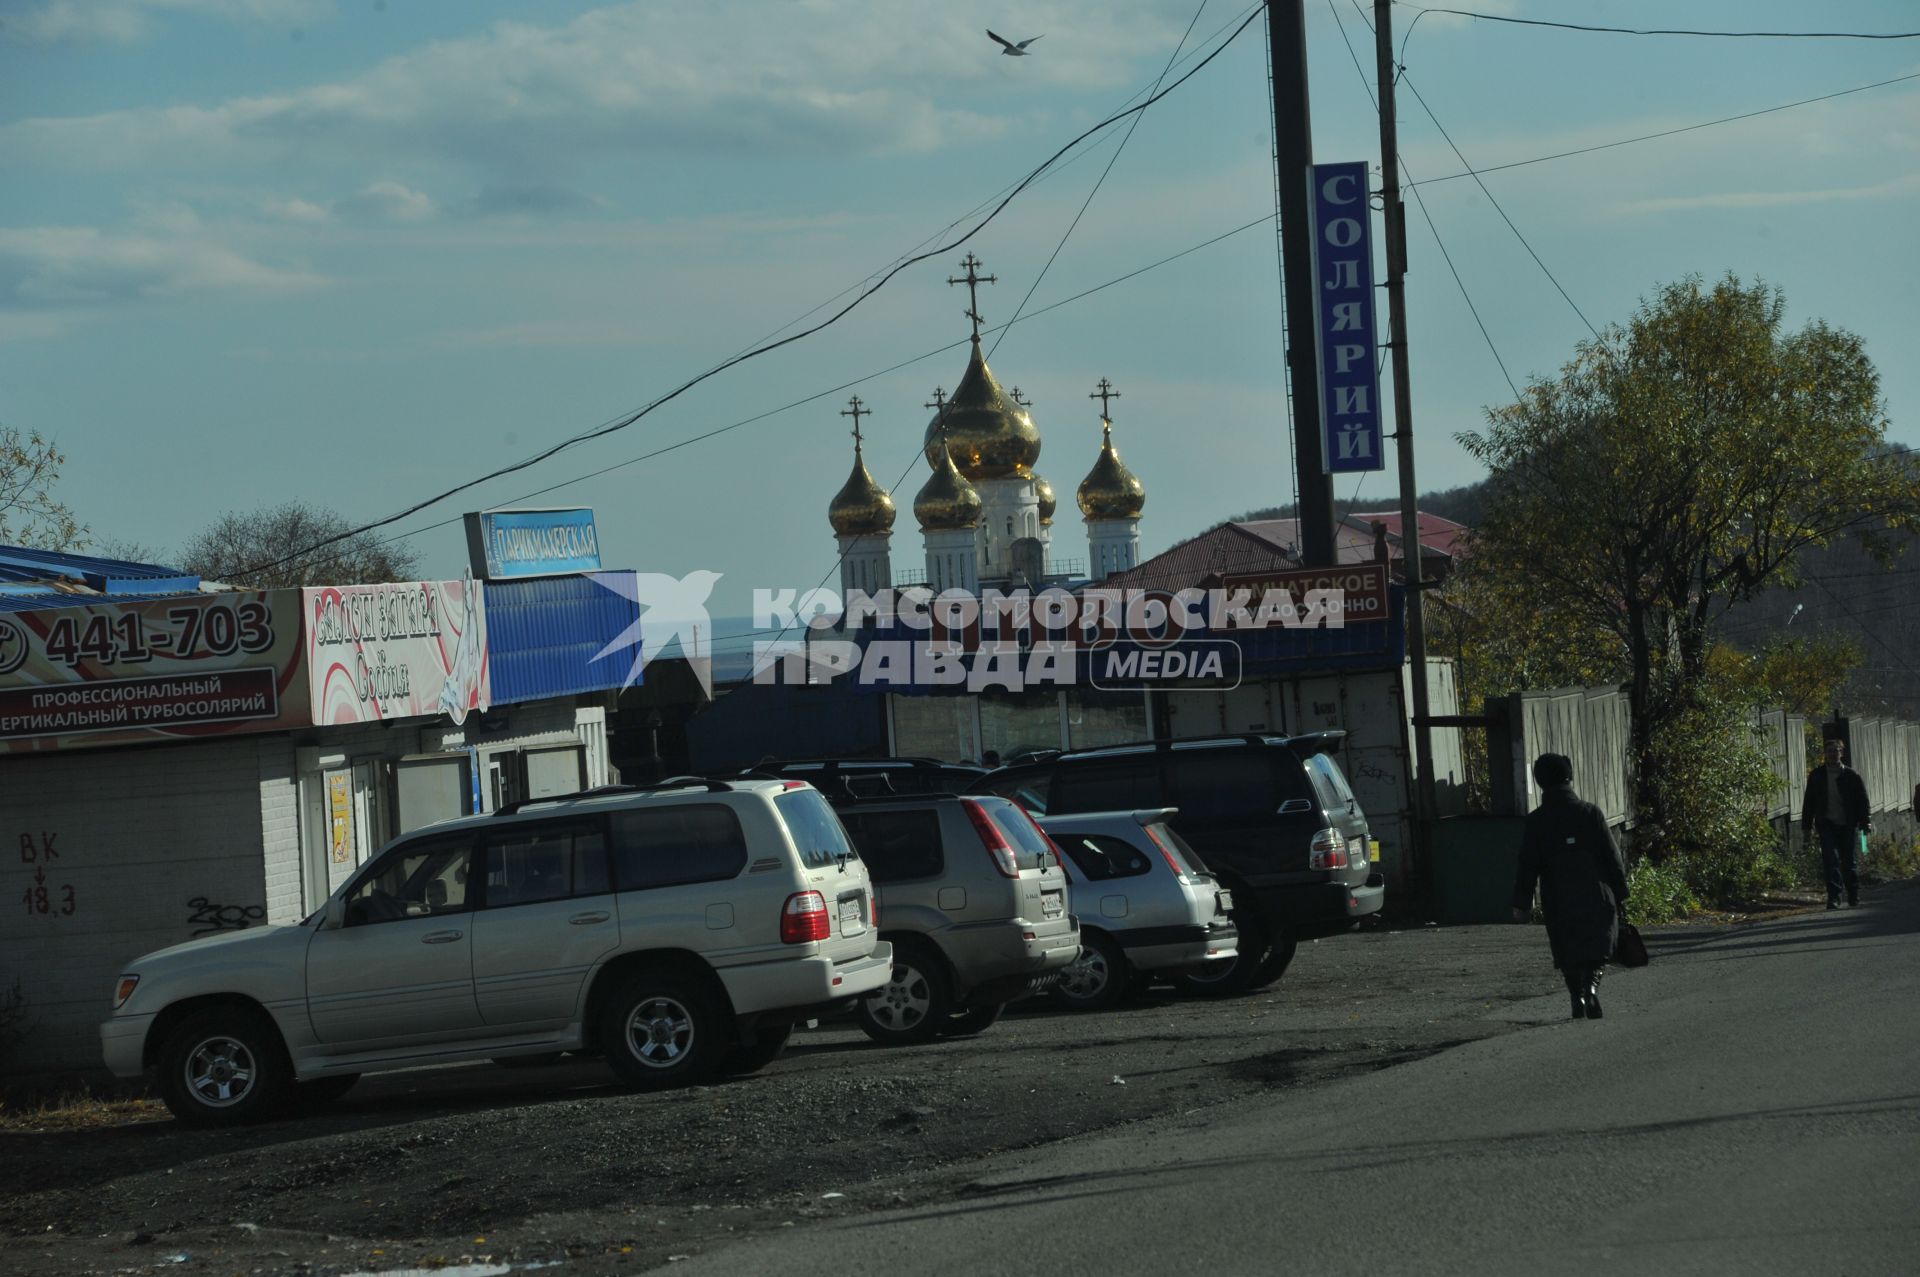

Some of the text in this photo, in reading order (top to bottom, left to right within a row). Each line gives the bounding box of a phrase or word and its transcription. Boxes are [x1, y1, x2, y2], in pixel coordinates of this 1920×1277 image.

[1322, 175, 1372, 461] СОЛЯРИЙ
[496, 524, 598, 562] ПАРИКМАХЕРСКАЯ
[1224, 597, 1379, 621] КРУГЛОСУТОЧНО
[1225, 573, 1377, 600] КАМЧАТСКОЕ
[45, 601, 276, 668] 441-703
[313, 589, 441, 646] САЛОН ЗАГАРА
[925, 589, 1188, 656] ПИВО
[32, 676, 222, 709] ПРОФЕССИОНАЛЬНЫЙ
[355, 649, 411, 713] София
[0, 693, 267, 731] ЕРТИКАЛЬНЫЙ ТУРБОСОЛЯРИЙ
